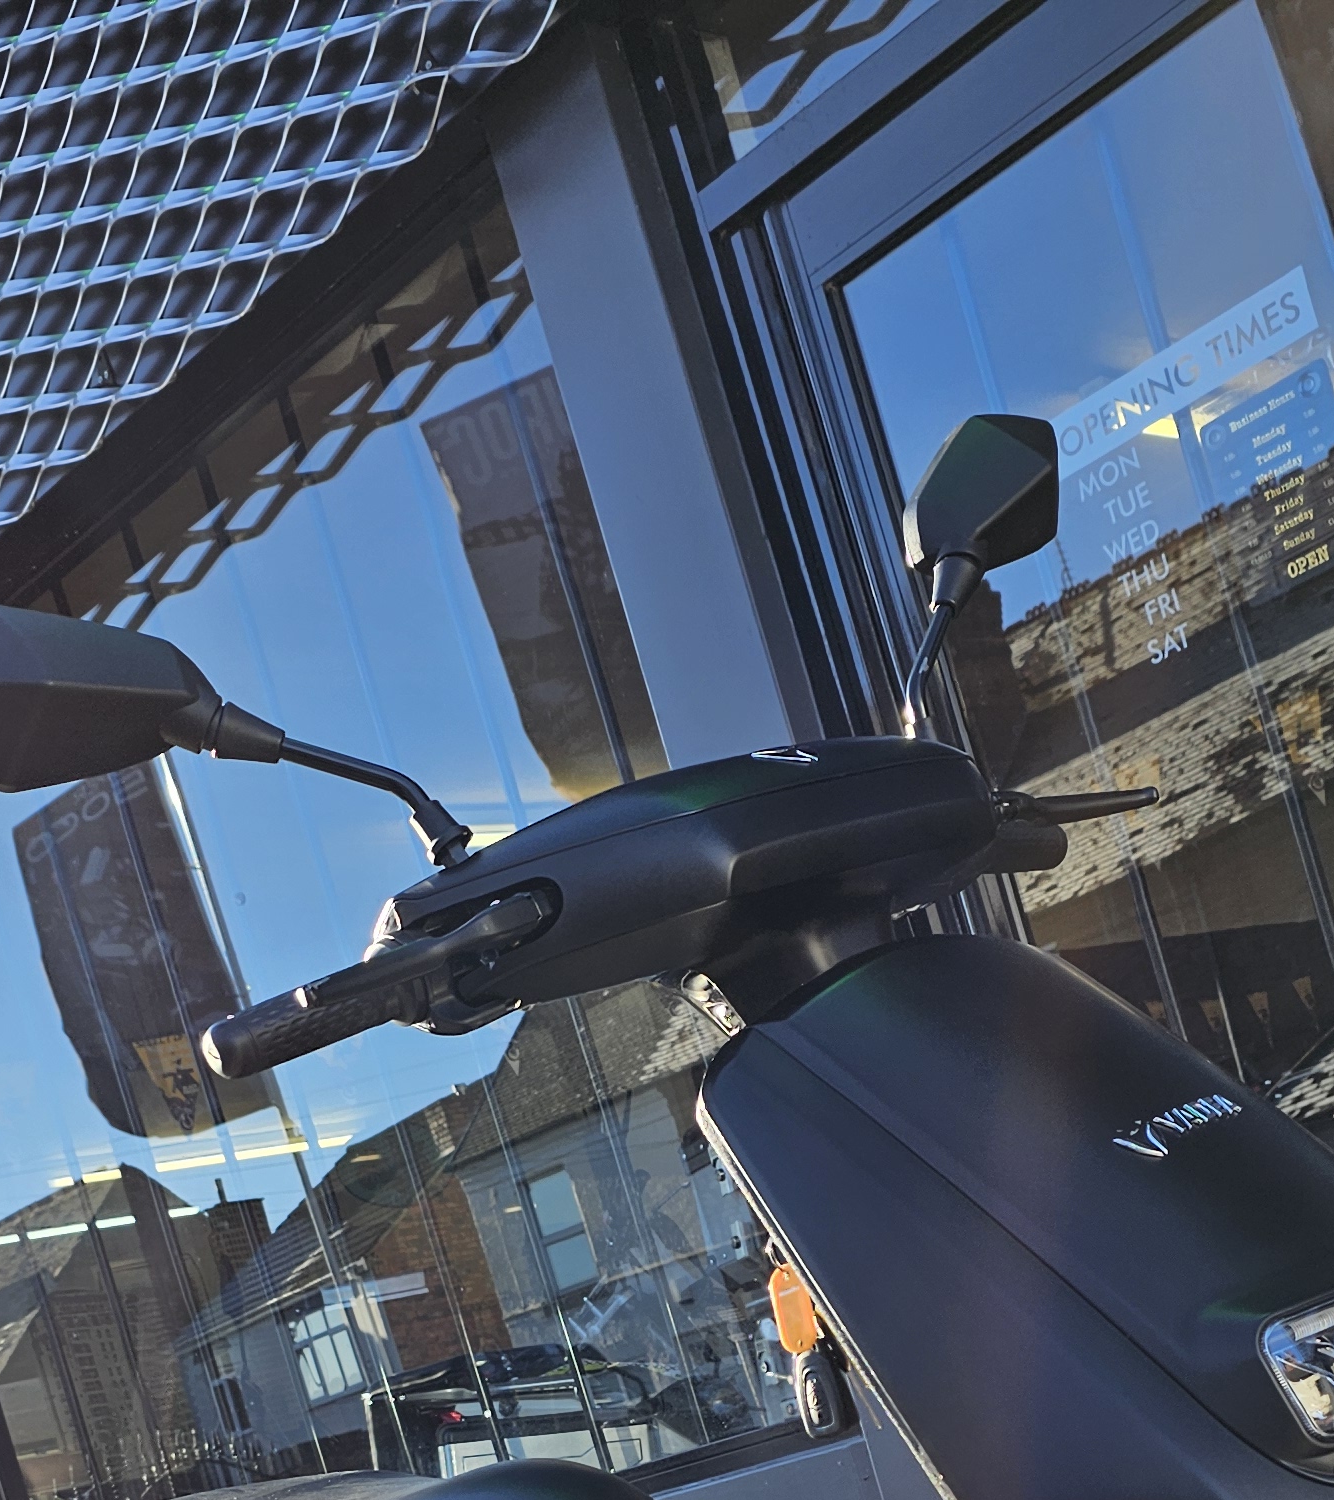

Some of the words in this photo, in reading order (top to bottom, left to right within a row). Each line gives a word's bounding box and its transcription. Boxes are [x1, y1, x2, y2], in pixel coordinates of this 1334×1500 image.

[1060, 354, 1200, 456] OPENING
[1205, 291, 1301, 367] TIMES
[1229, 404, 1269, 433] Business
[1268, 390, 1296, 414] Hours
[1252, 423, 1286, 448] Monday
[1256, 440, 1292, 466] Tuesday
[1078, 447, 1141, 502] MON
[1264, 473, 1306, 501] Thursday
[1103, 481, 1152, 524] TUE
[1274, 493, 1304, 516] Friday
[1274, 508, 1314, 535] Saturday
[1283, 528, 1316, 550] Sunday
[1103, 520, 1159, 563] WED
[1118, 553, 1170, 597] THU
[1287, 544, 1330, 579] OPEN
[1144, 588, 1182, 625] FRI
[1147, 623, 1188, 664] SAT
